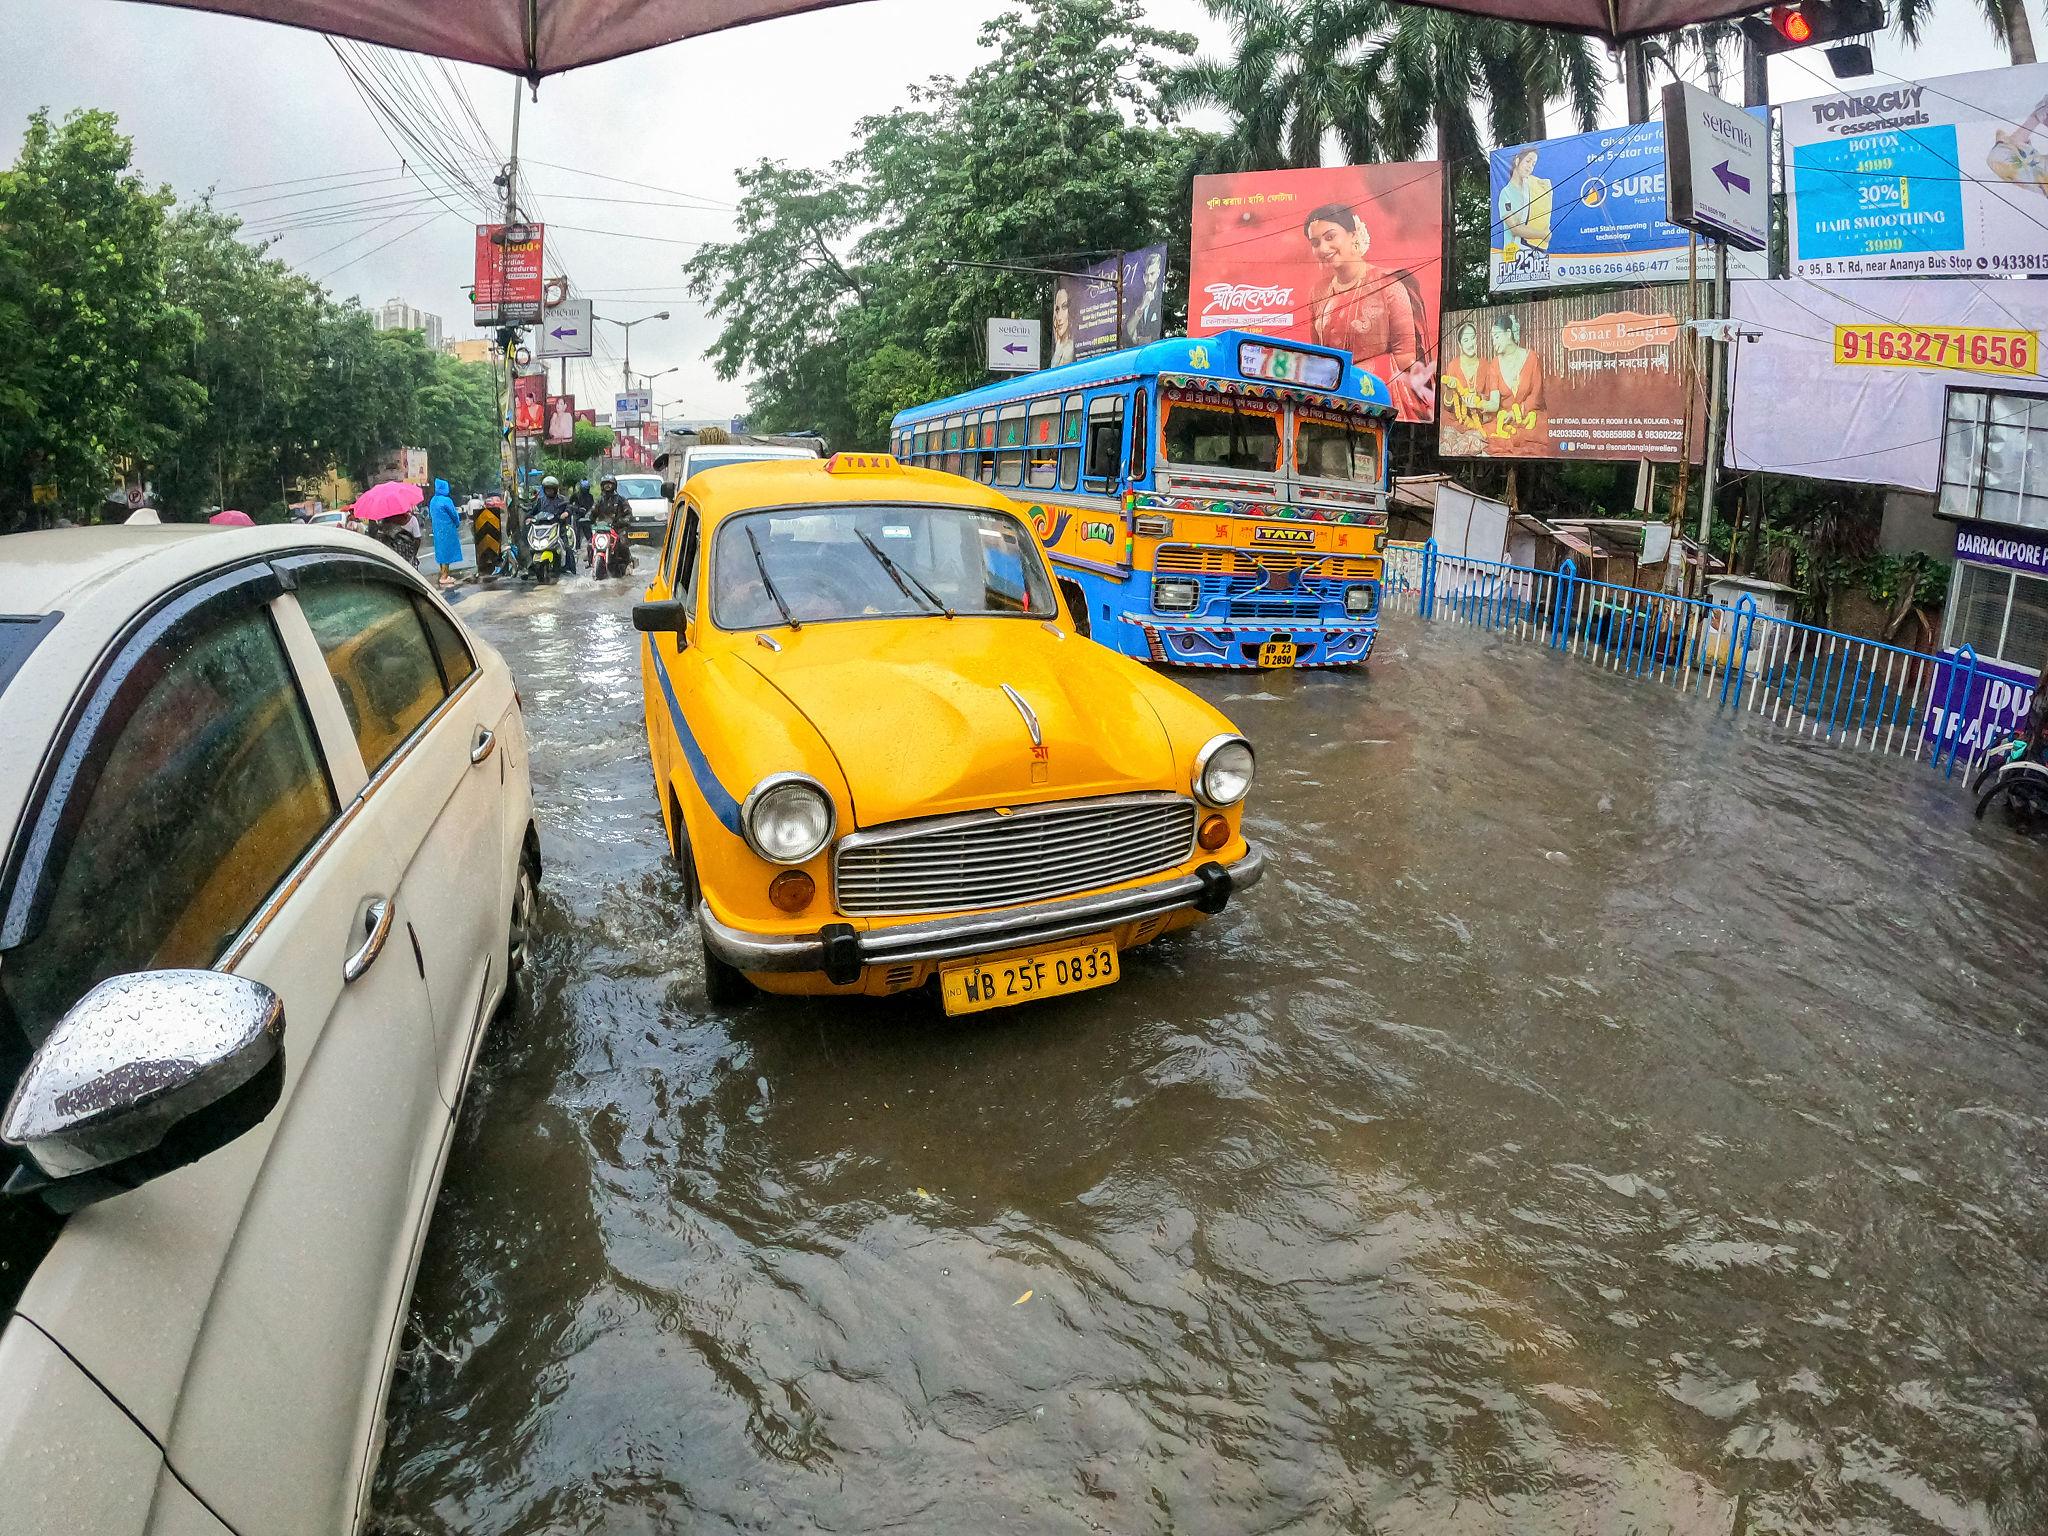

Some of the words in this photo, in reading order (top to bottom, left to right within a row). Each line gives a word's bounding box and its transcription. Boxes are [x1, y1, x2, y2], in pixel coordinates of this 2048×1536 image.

[1812, 86, 1927, 124] TONI&GUY
[1840, 111, 1930, 136] essensuals
[1600, 136, 1625, 147] Give
[1628, 132, 1653, 146] your
[1849, 135, 1900, 153] BOTOX
[1587, 152, 1605, 164] the
[1606, 148, 1642, 161] 5-star
[1611, 174, 1665, 198] SURE
[1858, 184, 1899, 204] 30%
[1580, 225, 1598, 234] Latest
[1616, 222, 1648, 232] removing
[1815, 217, 1851, 234] HAIR
[1854, 211, 1946, 229] SMOOTHING
[1595, 232, 1631, 241] technology
[1568, 265, 1587, 275] 033
[1589, 264, 1602, 274] 66
[1603, 263, 1623, 273] 266
[1809, 264, 1823, 276] 95,
[1826, 263, 1836, 274] B.
[1838, 262, 1847, 273] T.
[1849, 260, 1864, 274] Rd,
[1866, 261, 1887, 271] near
[1890, 256, 1925, 271] Ananya
[1928, 256, 1947, 269] Bus
[1949, 256, 1972, 270] Stop
[1202, 282, 1294, 314] শ্রীনিকেতন
[1570, 327, 1612, 342] Sonar
[1616, 319, 1668, 342] Bangla
[1843, 331, 2028, 368] 9163271656
[1603, 359, 1617, 369] সব
[1643, 417, 1670, 425] KOLKATA
[1637, 430, 1644, 439] &
[1576, 442, 1596, 451] Follow
[844, 456, 890, 468] TAXI
[1261, 529, 1308, 541] TATA
[1957, 532, 2042, 566] BARRACKPORE
[1265, 644, 1278, 654] WB
[1281, 644, 1291, 654] 23
[1271, 655, 1292, 665] 2890
[964, 972, 996, 1003] WB
[1003, 962, 1046, 997] 25F
[1055, 951, 1113, 986] 0833
